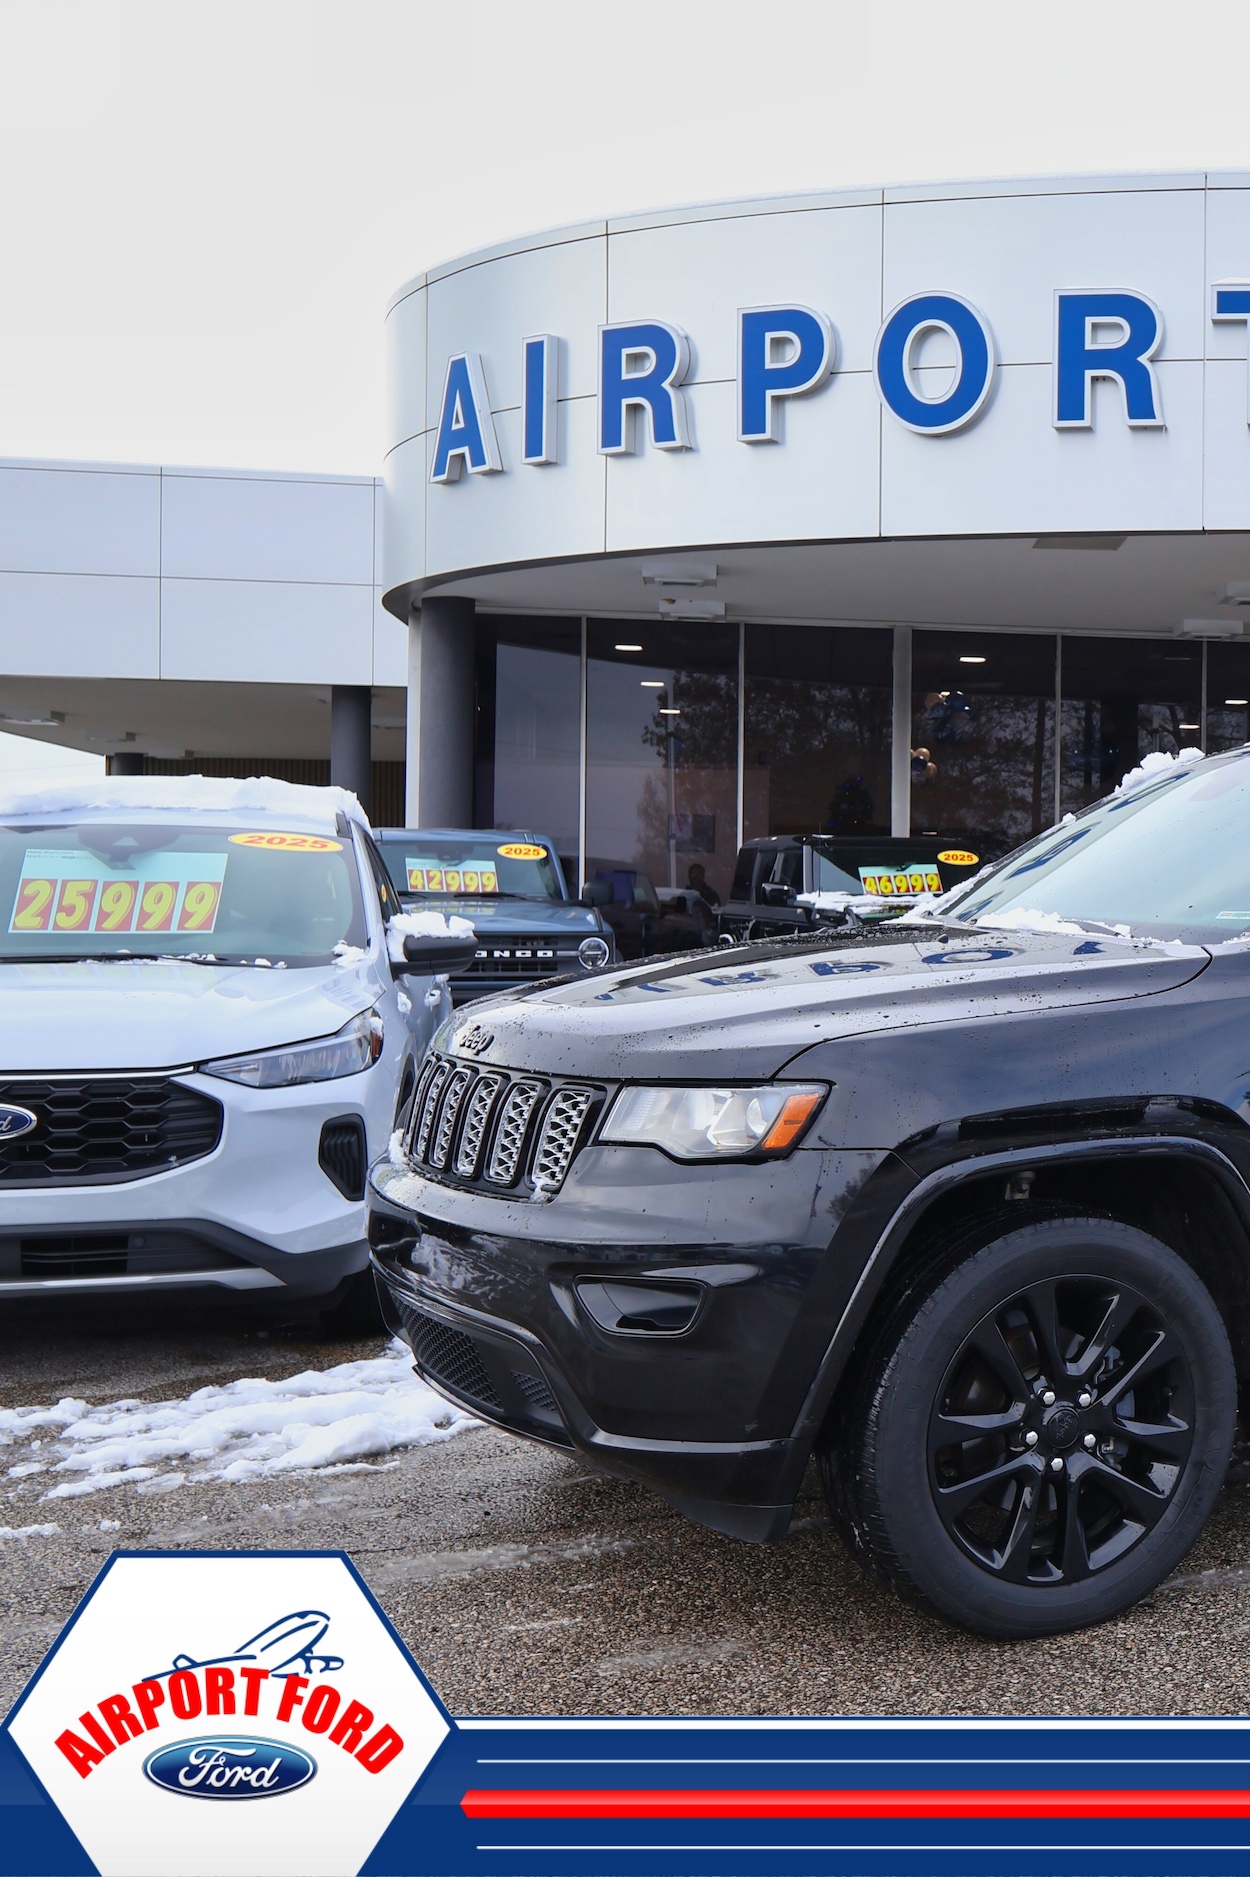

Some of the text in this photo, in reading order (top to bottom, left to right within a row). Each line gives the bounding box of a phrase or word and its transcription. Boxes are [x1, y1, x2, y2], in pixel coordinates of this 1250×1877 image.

[243, 835, 330, 849] 2025
[504, 847, 541, 857] 2025
[943, 853, 974, 862] 2025
[409, 870, 497, 892] 42999
[864, 873, 939, 894] 46999
[14, 880, 218, 929] 25999
[474, 950, 553, 958] ONCO
[460, 1025, 494, 1056] Jeep
